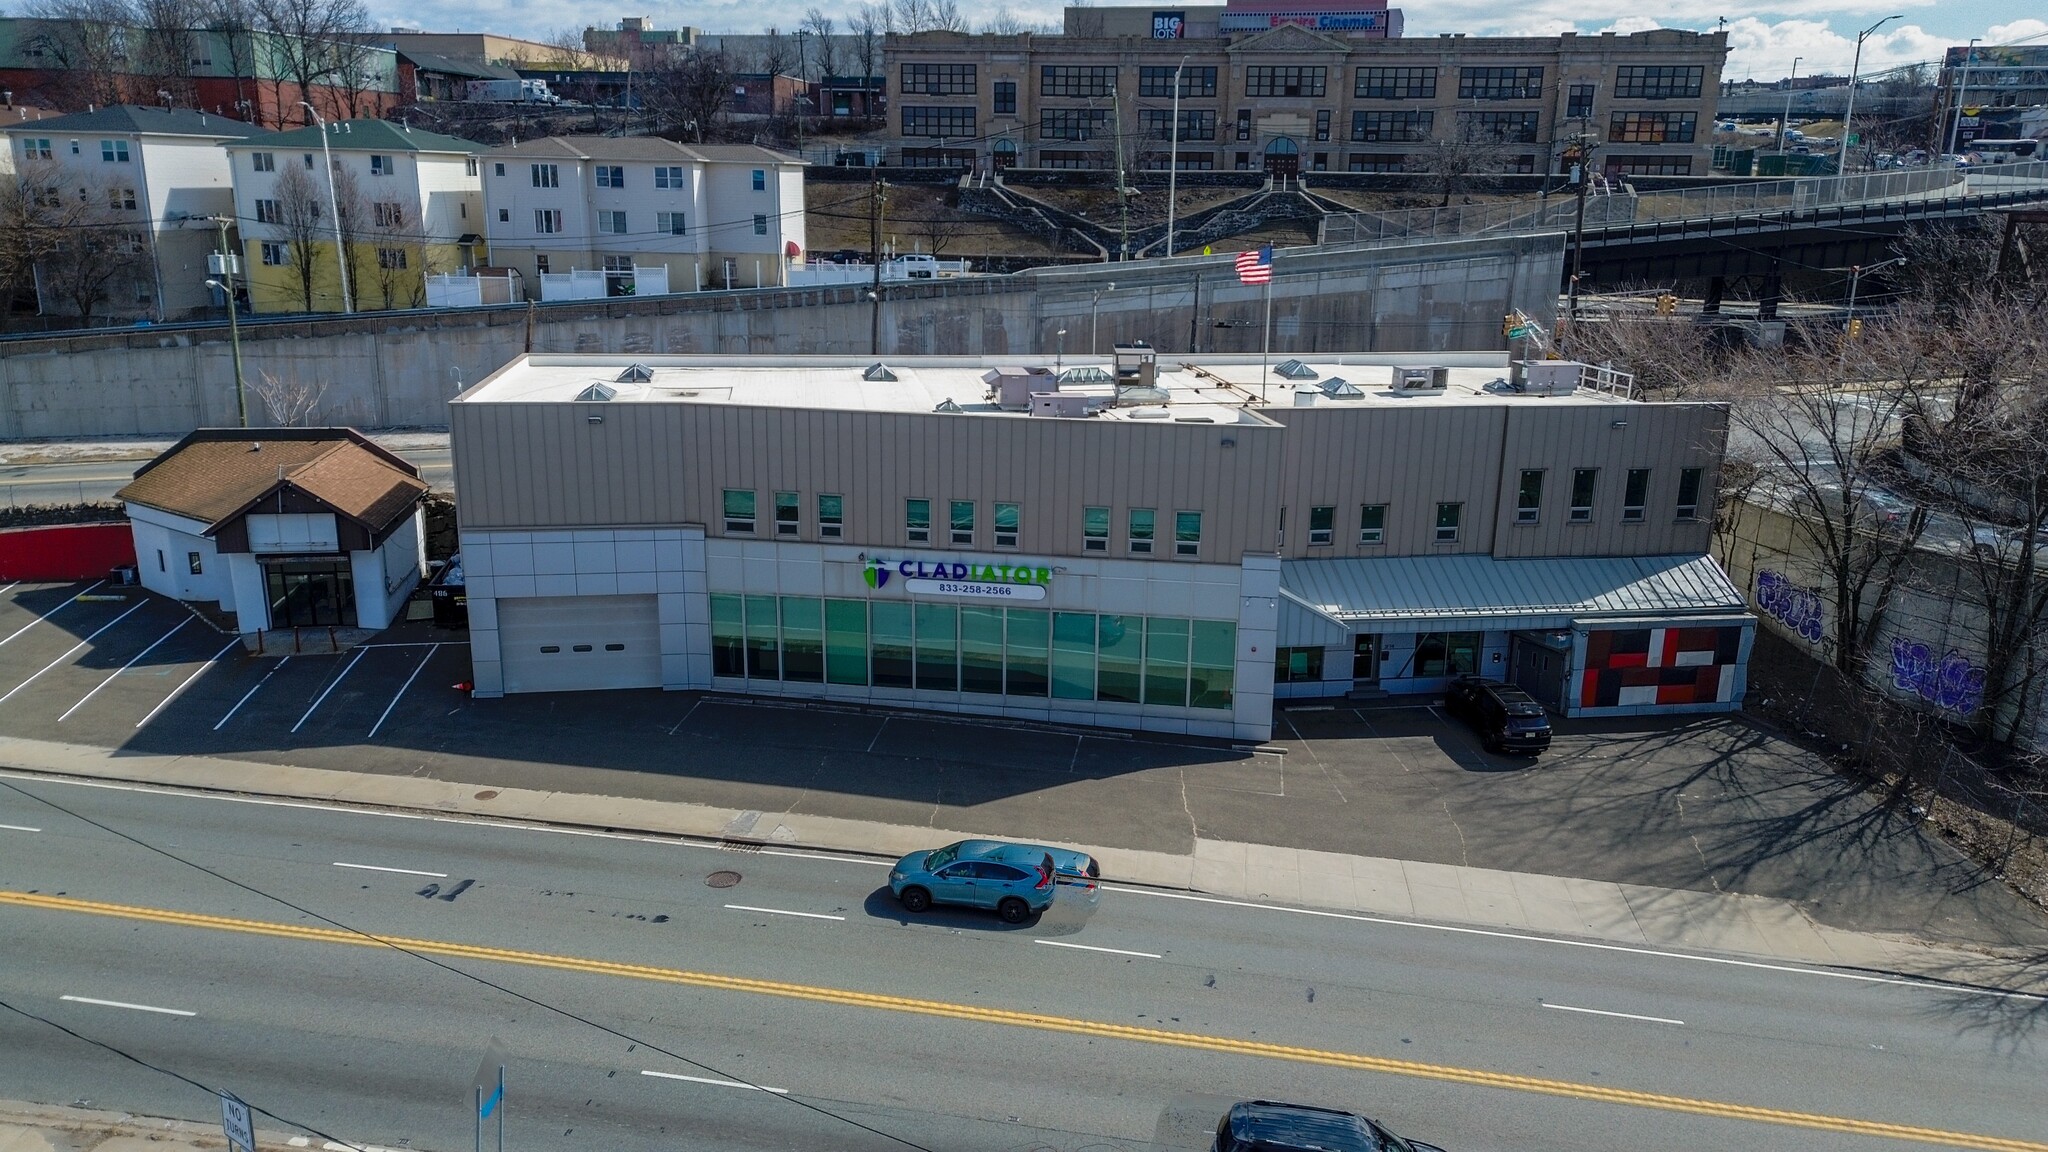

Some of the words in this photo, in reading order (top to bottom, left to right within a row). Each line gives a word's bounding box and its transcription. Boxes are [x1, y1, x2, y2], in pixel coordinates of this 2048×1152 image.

[1154, 17, 1180, 29] BIG
[1320, 15, 1375, 27] Cinemas
[1153, 29, 1176, 39] LOTS
[899, 560, 1049, 584] CLADIATOR
[939, 584, 1012, 596] 833-258-2566
[228, 1103, 242, 1121] NO
[226, 1118, 249, 1143] TURNS
